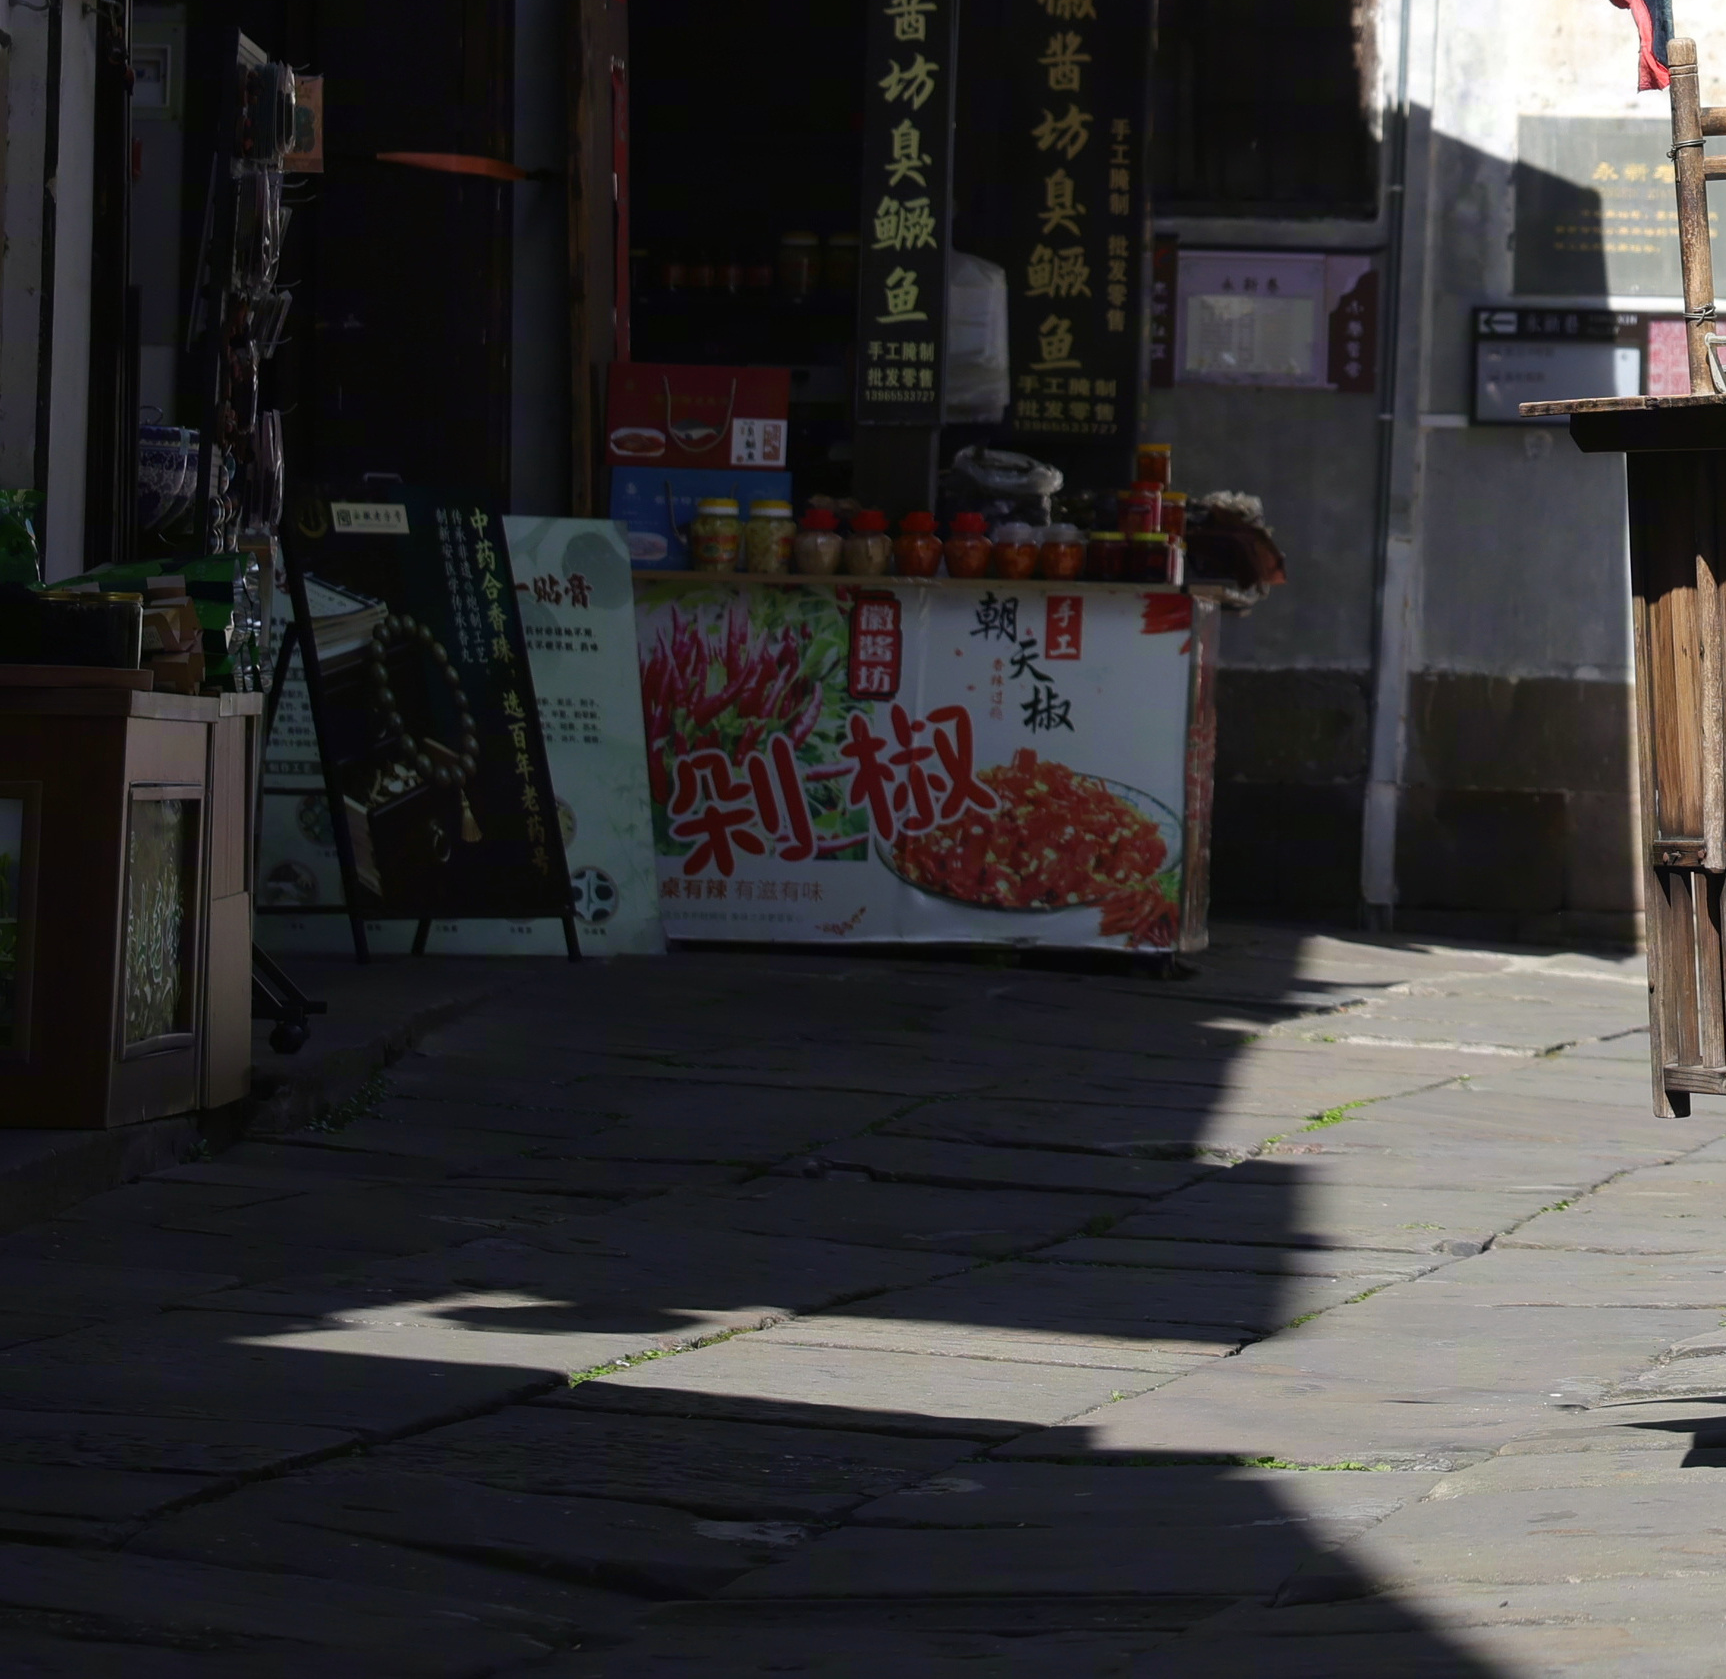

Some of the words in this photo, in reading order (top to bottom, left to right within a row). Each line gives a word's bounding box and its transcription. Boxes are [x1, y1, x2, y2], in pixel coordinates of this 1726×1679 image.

[856, 602, 898, 696] 徽酱坊
[970, 591, 1075, 734] 朝天椒
[1049, 597, 1078, 657] 手工
[671, 703, 998, 878] 剁椒
